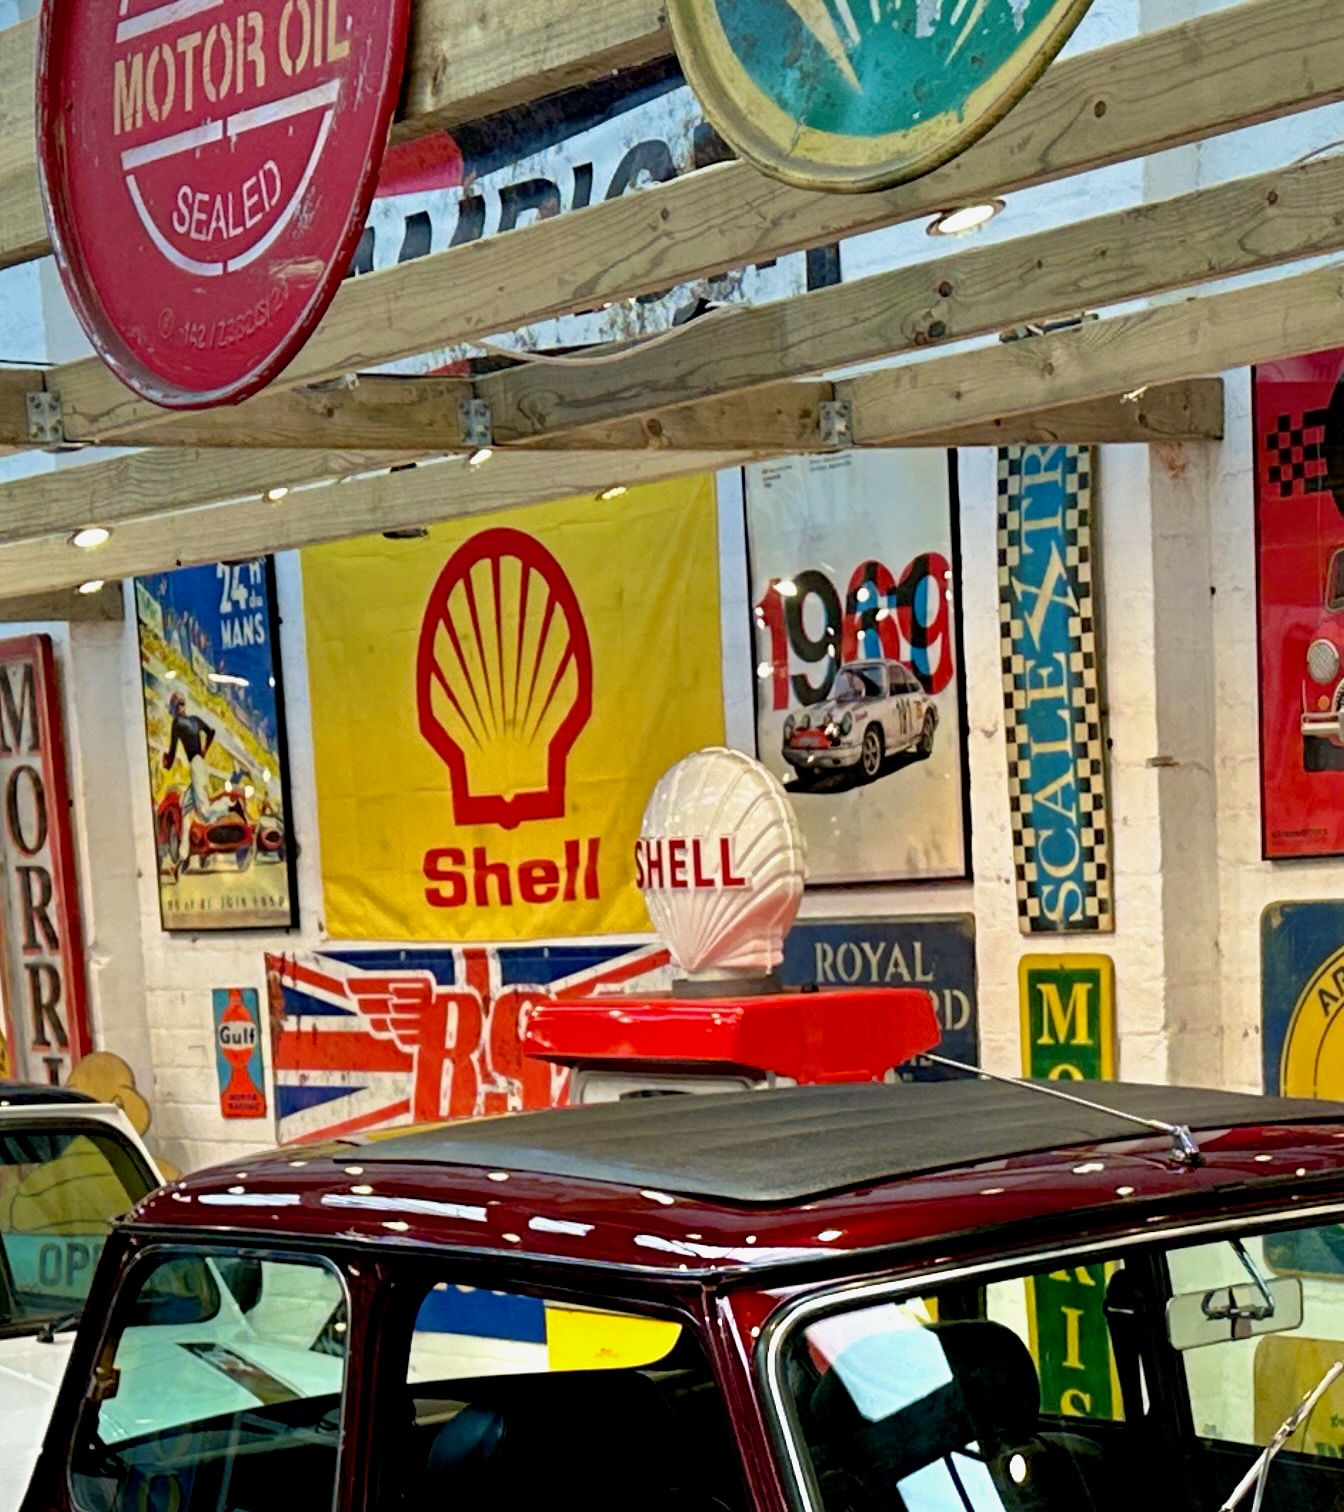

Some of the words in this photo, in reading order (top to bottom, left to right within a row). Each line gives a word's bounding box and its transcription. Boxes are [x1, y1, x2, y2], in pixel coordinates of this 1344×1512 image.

[113, 11, 266, 136] MOTOR
[279, 0, 350, 76] OIL
[173, 159, 282, 242] SEALED
[216, 562, 248, 614] 24
[221, 613, 265, 650] MANS
[755, 551, 954, 711] 1969
[423, 837, 601, 908] Shell
[634, 837, 748, 889] SHELL
[815, 941, 935, 984] ROYAL
[220, 1026, 256, 1045] Gulf
[413, 991, 570, 1122] BS
[40, 1242, 99, 1287] OP
